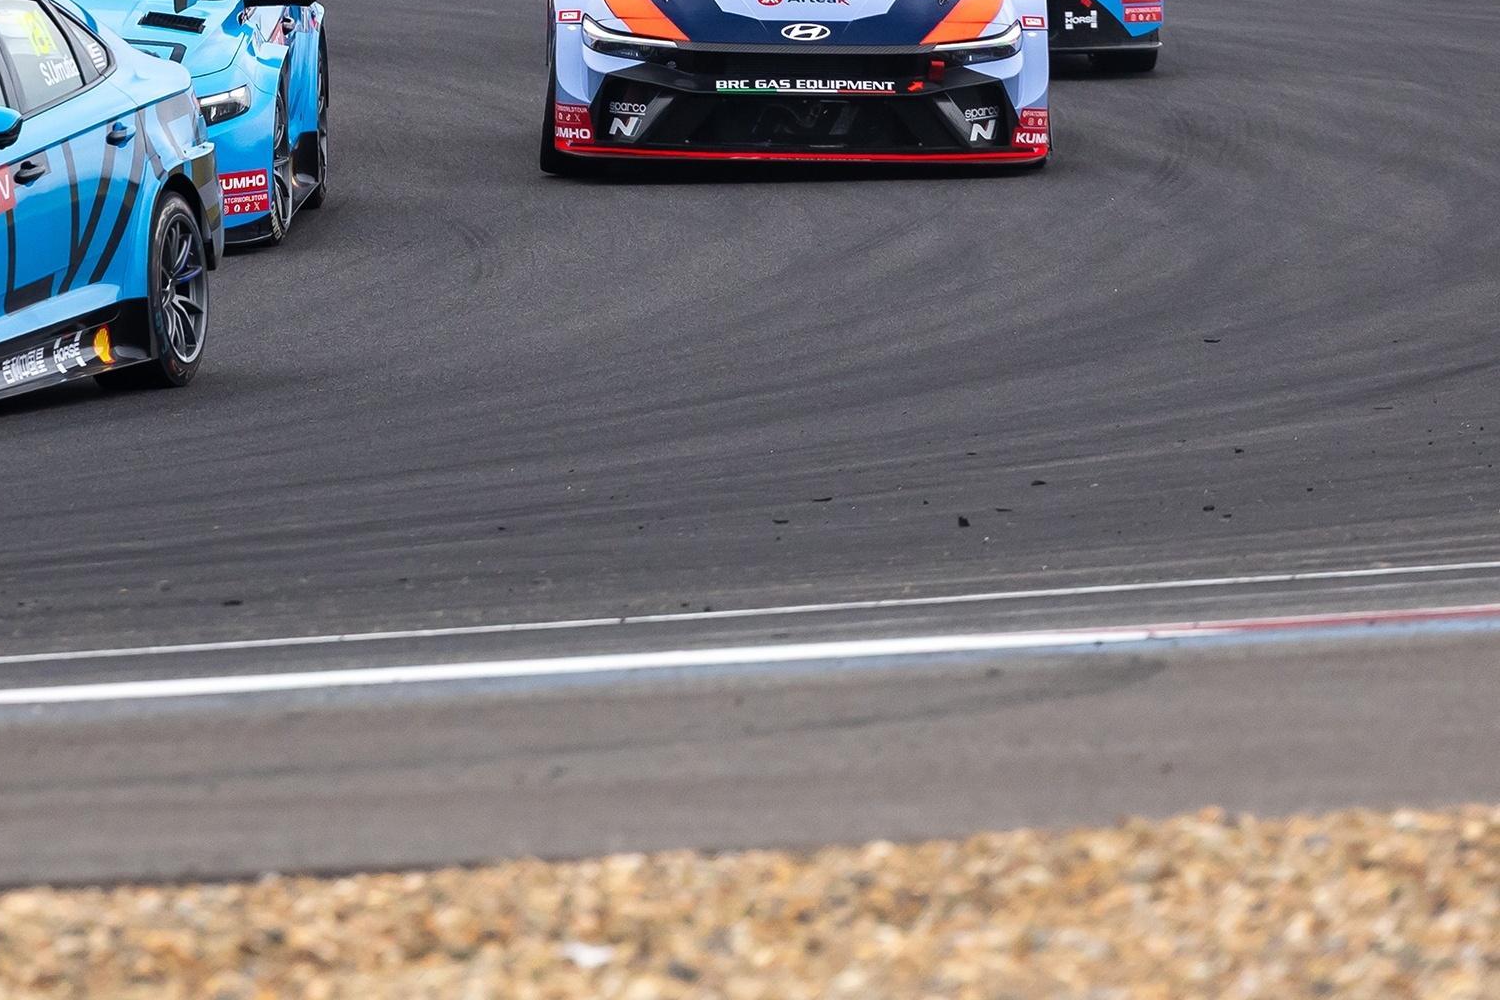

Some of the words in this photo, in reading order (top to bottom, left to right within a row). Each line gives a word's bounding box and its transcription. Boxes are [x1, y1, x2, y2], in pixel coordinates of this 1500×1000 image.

[715, 79, 750, 89] BRC
[754, 79, 791, 89] GAS
[795, 79, 896, 91] EQUIPMENT
[609, 101, 647, 114] sparco
[556, 126, 591, 139] MHO
[1015, 132, 1048, 144] KUM
[219, 173, 266, 190] UMHO
